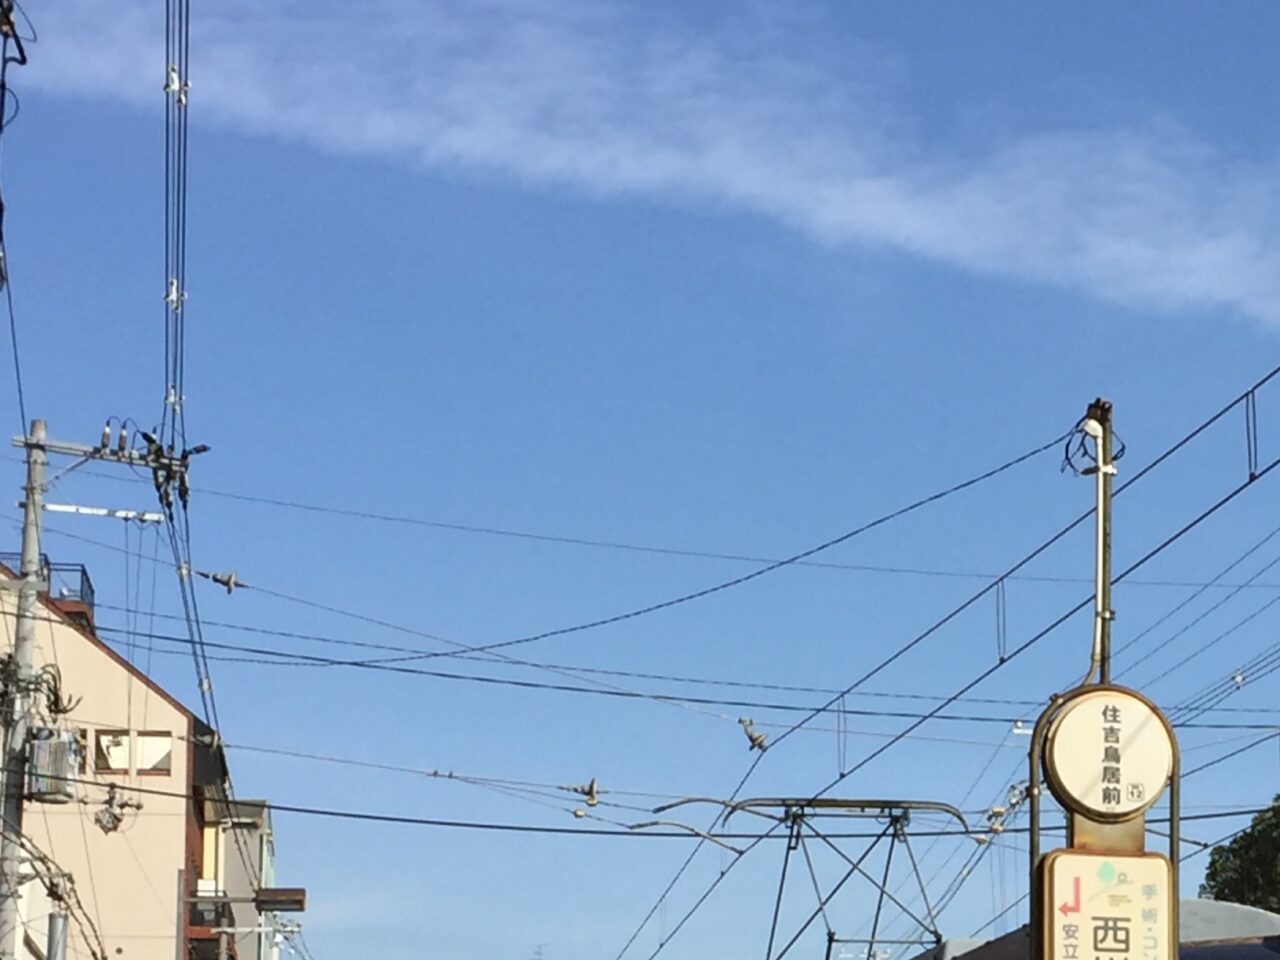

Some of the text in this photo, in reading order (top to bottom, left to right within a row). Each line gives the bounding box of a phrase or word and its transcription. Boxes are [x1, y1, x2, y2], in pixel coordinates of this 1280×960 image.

[1101, 705, 1122, 805] 住吉鳥居前
